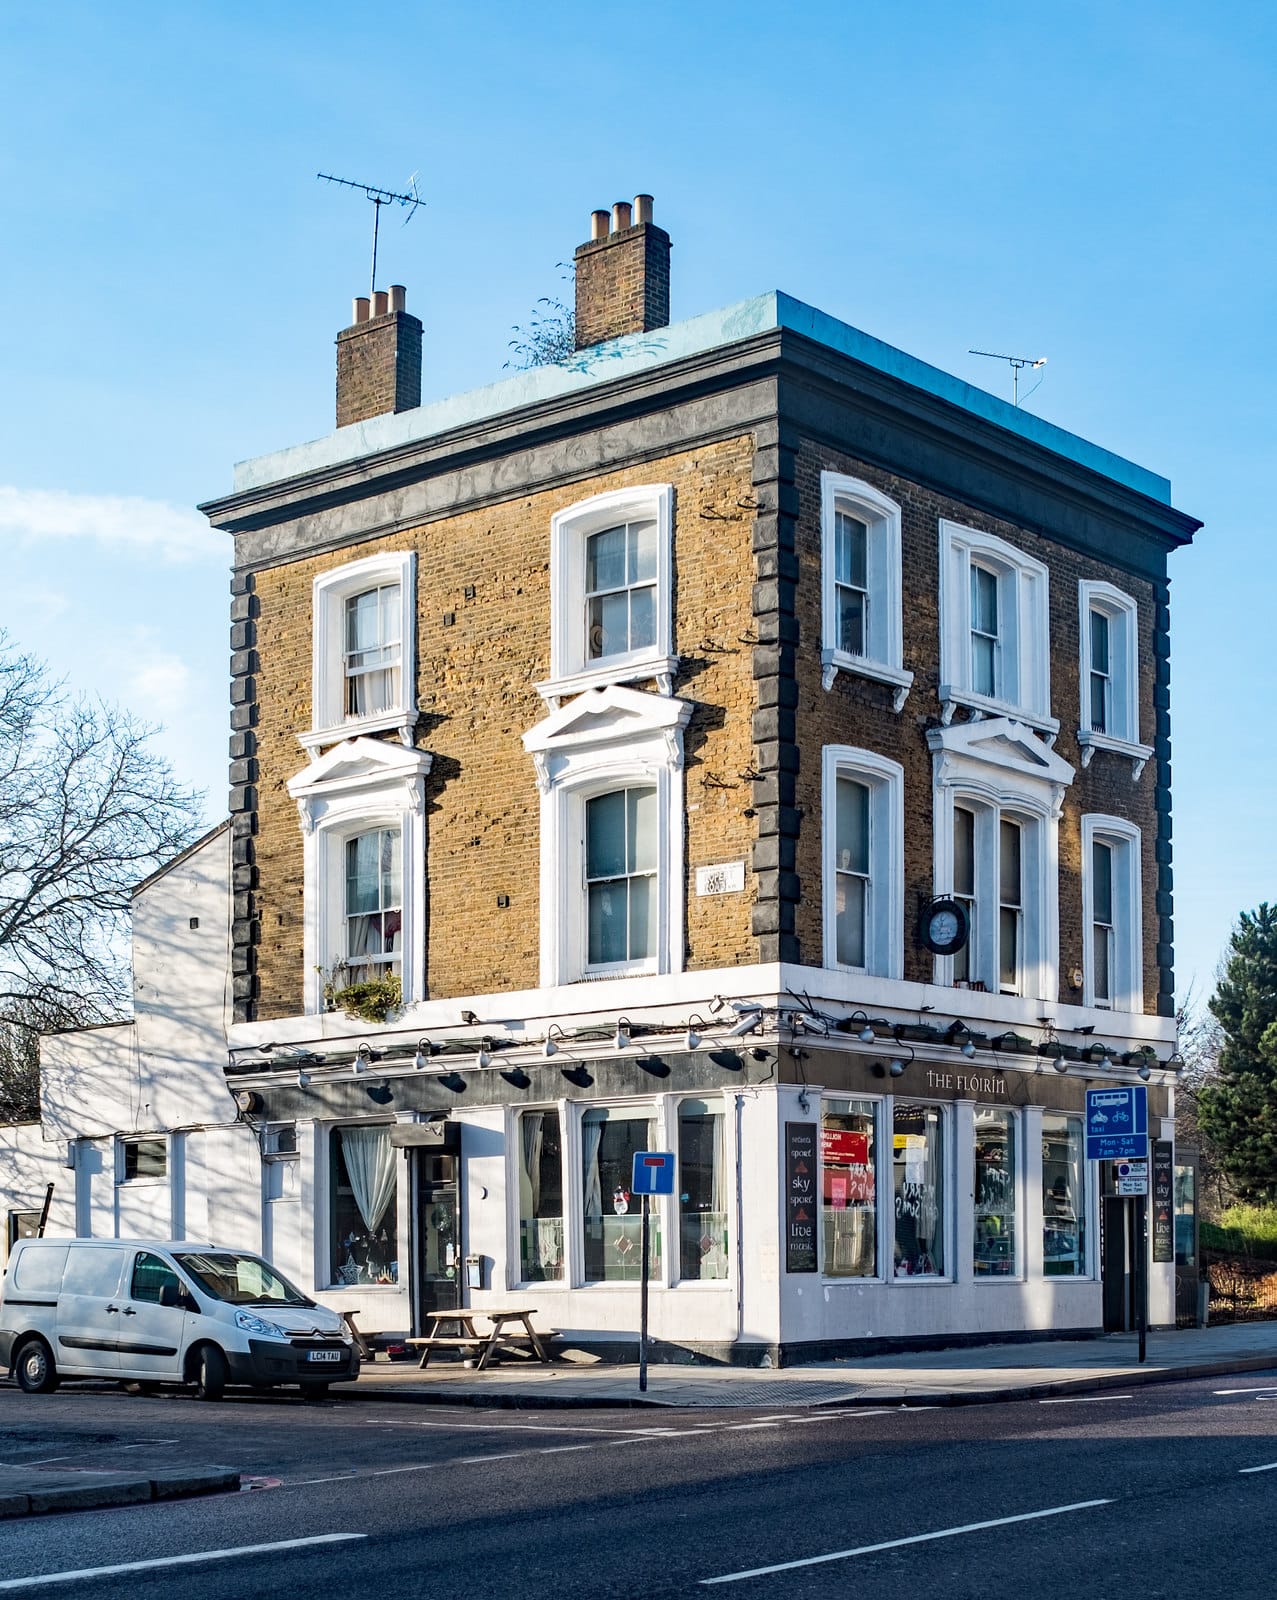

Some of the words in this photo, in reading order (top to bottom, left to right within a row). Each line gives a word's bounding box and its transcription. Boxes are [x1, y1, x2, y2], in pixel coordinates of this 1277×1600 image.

[926, 1070, 953, 1089] THE
[1091, 1125, 1105, 1133] taxi
[1100, 1138, 1116, 1147] Mon
[1121, 1137, 1134, 1146] Sat
[792, 1175, 811, 1193] sky
[1156, 1184, 1170, 1198] sky
[791, 1223, 812, 1237] live
[790, 1241, 813, 1251] music
[327, 1352, 339, 1361] TAU
